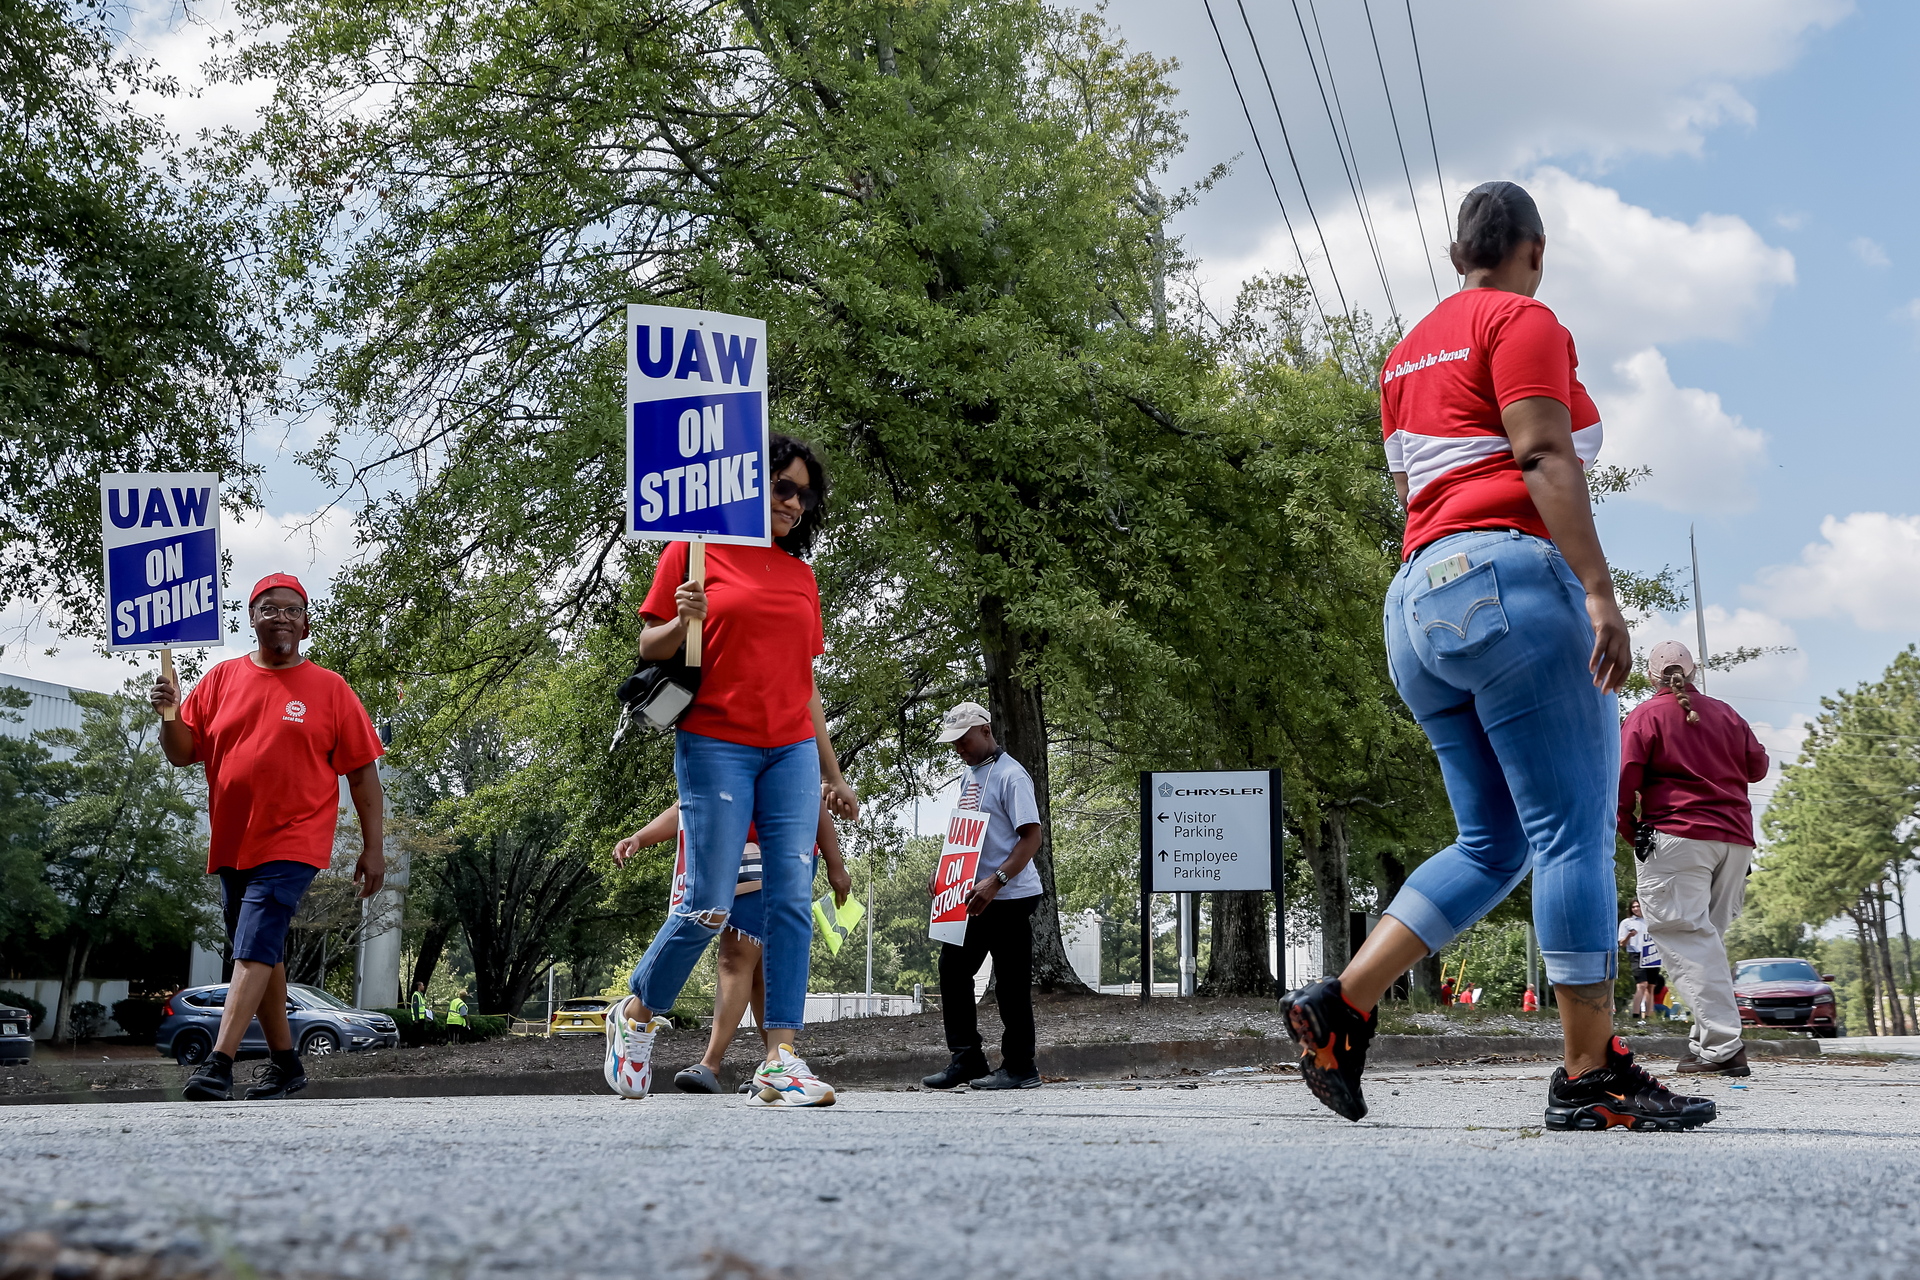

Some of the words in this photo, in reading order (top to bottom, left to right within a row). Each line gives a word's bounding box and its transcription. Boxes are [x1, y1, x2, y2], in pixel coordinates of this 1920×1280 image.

[637, 325, 757, 387] UAW
[1438, 347, 1470, 362] Currency
[678, 404, 724, 458] ON
[640, 451, 759, 522] STRIKE
[108, 488, 211, 529] UAW
[145, 543, 184, 587] ON
[116, 575, 214, 638] STRIKE
[1175, 788, 1263, 796] CHRYSLER
[948, 817, 985, 847] UAW
[1174, 811, 1217, 823] Visitor
[1174, 825, 1224, 840] Parking
[945, 856, 965, 886] ON
[1174, 850, 1238, 865] Employee
[1174, 866, 1221, 880] Parking
